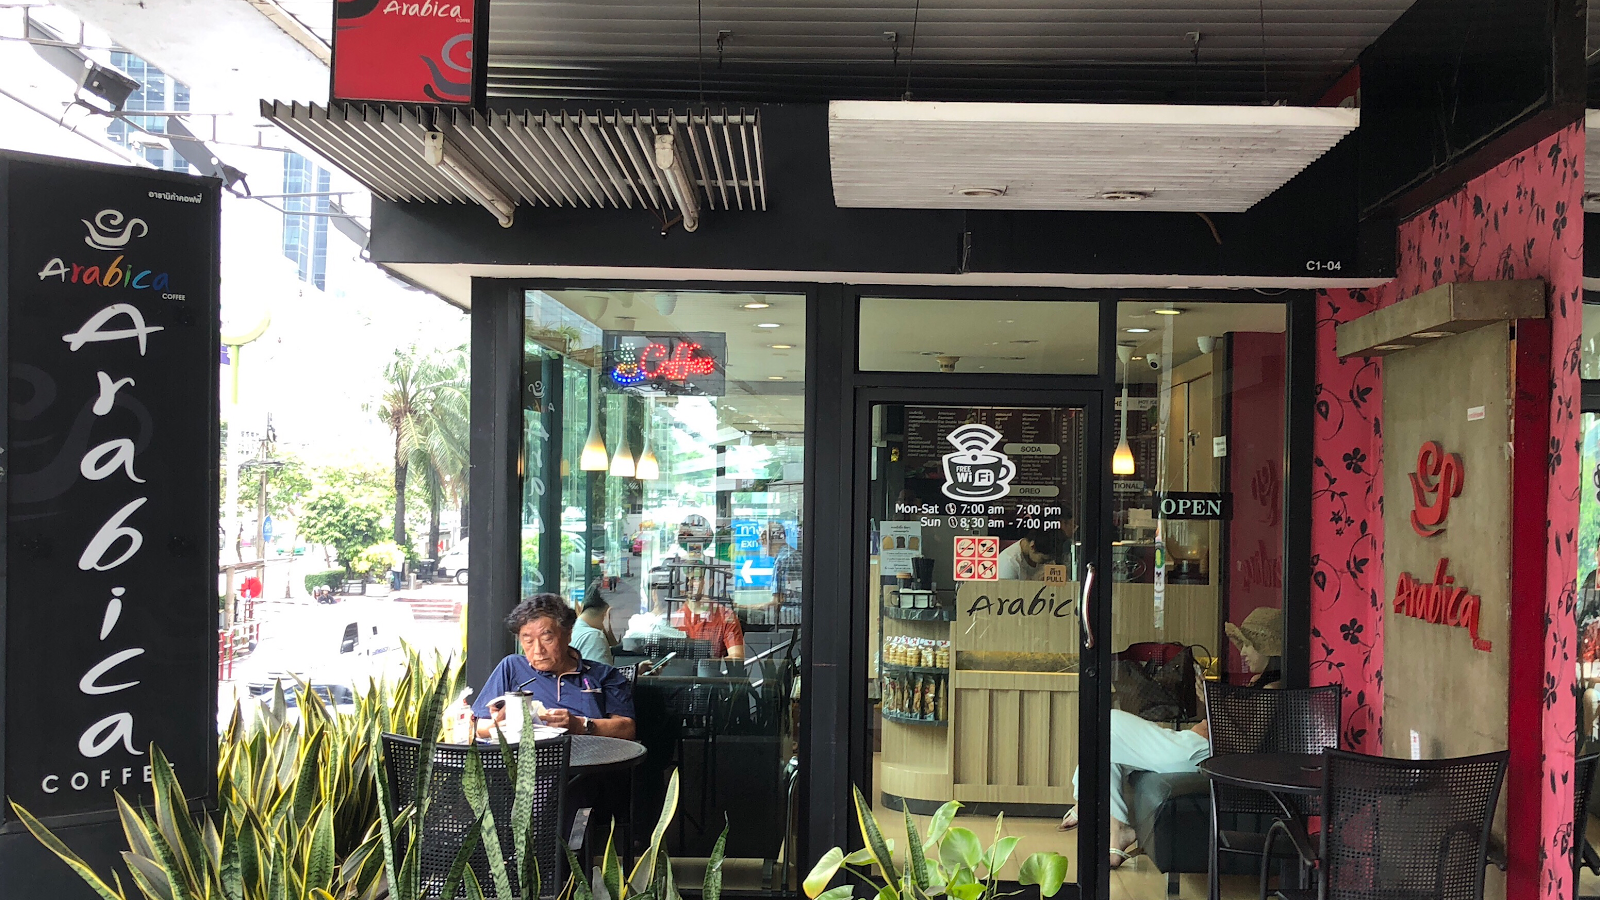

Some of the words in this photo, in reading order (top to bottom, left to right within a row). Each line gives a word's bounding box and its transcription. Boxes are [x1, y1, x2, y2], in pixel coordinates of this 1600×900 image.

[383, 0, 461, 18] Arabica
[38, 255, 170, 292] Arabica
[1307, 260, 1341, 271] C1-04
[162, 293, 186, 301] COFFEE
[1020, 445, 1042, 453] SODA
[955, 465, 972, 473] FREE
[895, 503, 939, 515] Mon-Sat
[960, 504, 985, 515] 7:00
[987, 506, 1005, 515] am
[1016, 504, 1041, 516] 7:00
[1043, 506, 1061, 518] pm
[1160, 498, 1222, 516] OPEN
[920, 517, 941, 528] Sun
[959, 517, 985, 529] 8:30
[987, 519, 1005, 529] am
[1016, 518, 1041, 530] 7:00
[1043, 520, 1061, 532] pm
[967, 585, 1079, 617] Arabic
[1393, 557, 1480, 640] Arabica
[42, 762, 175, 794] COFFE
